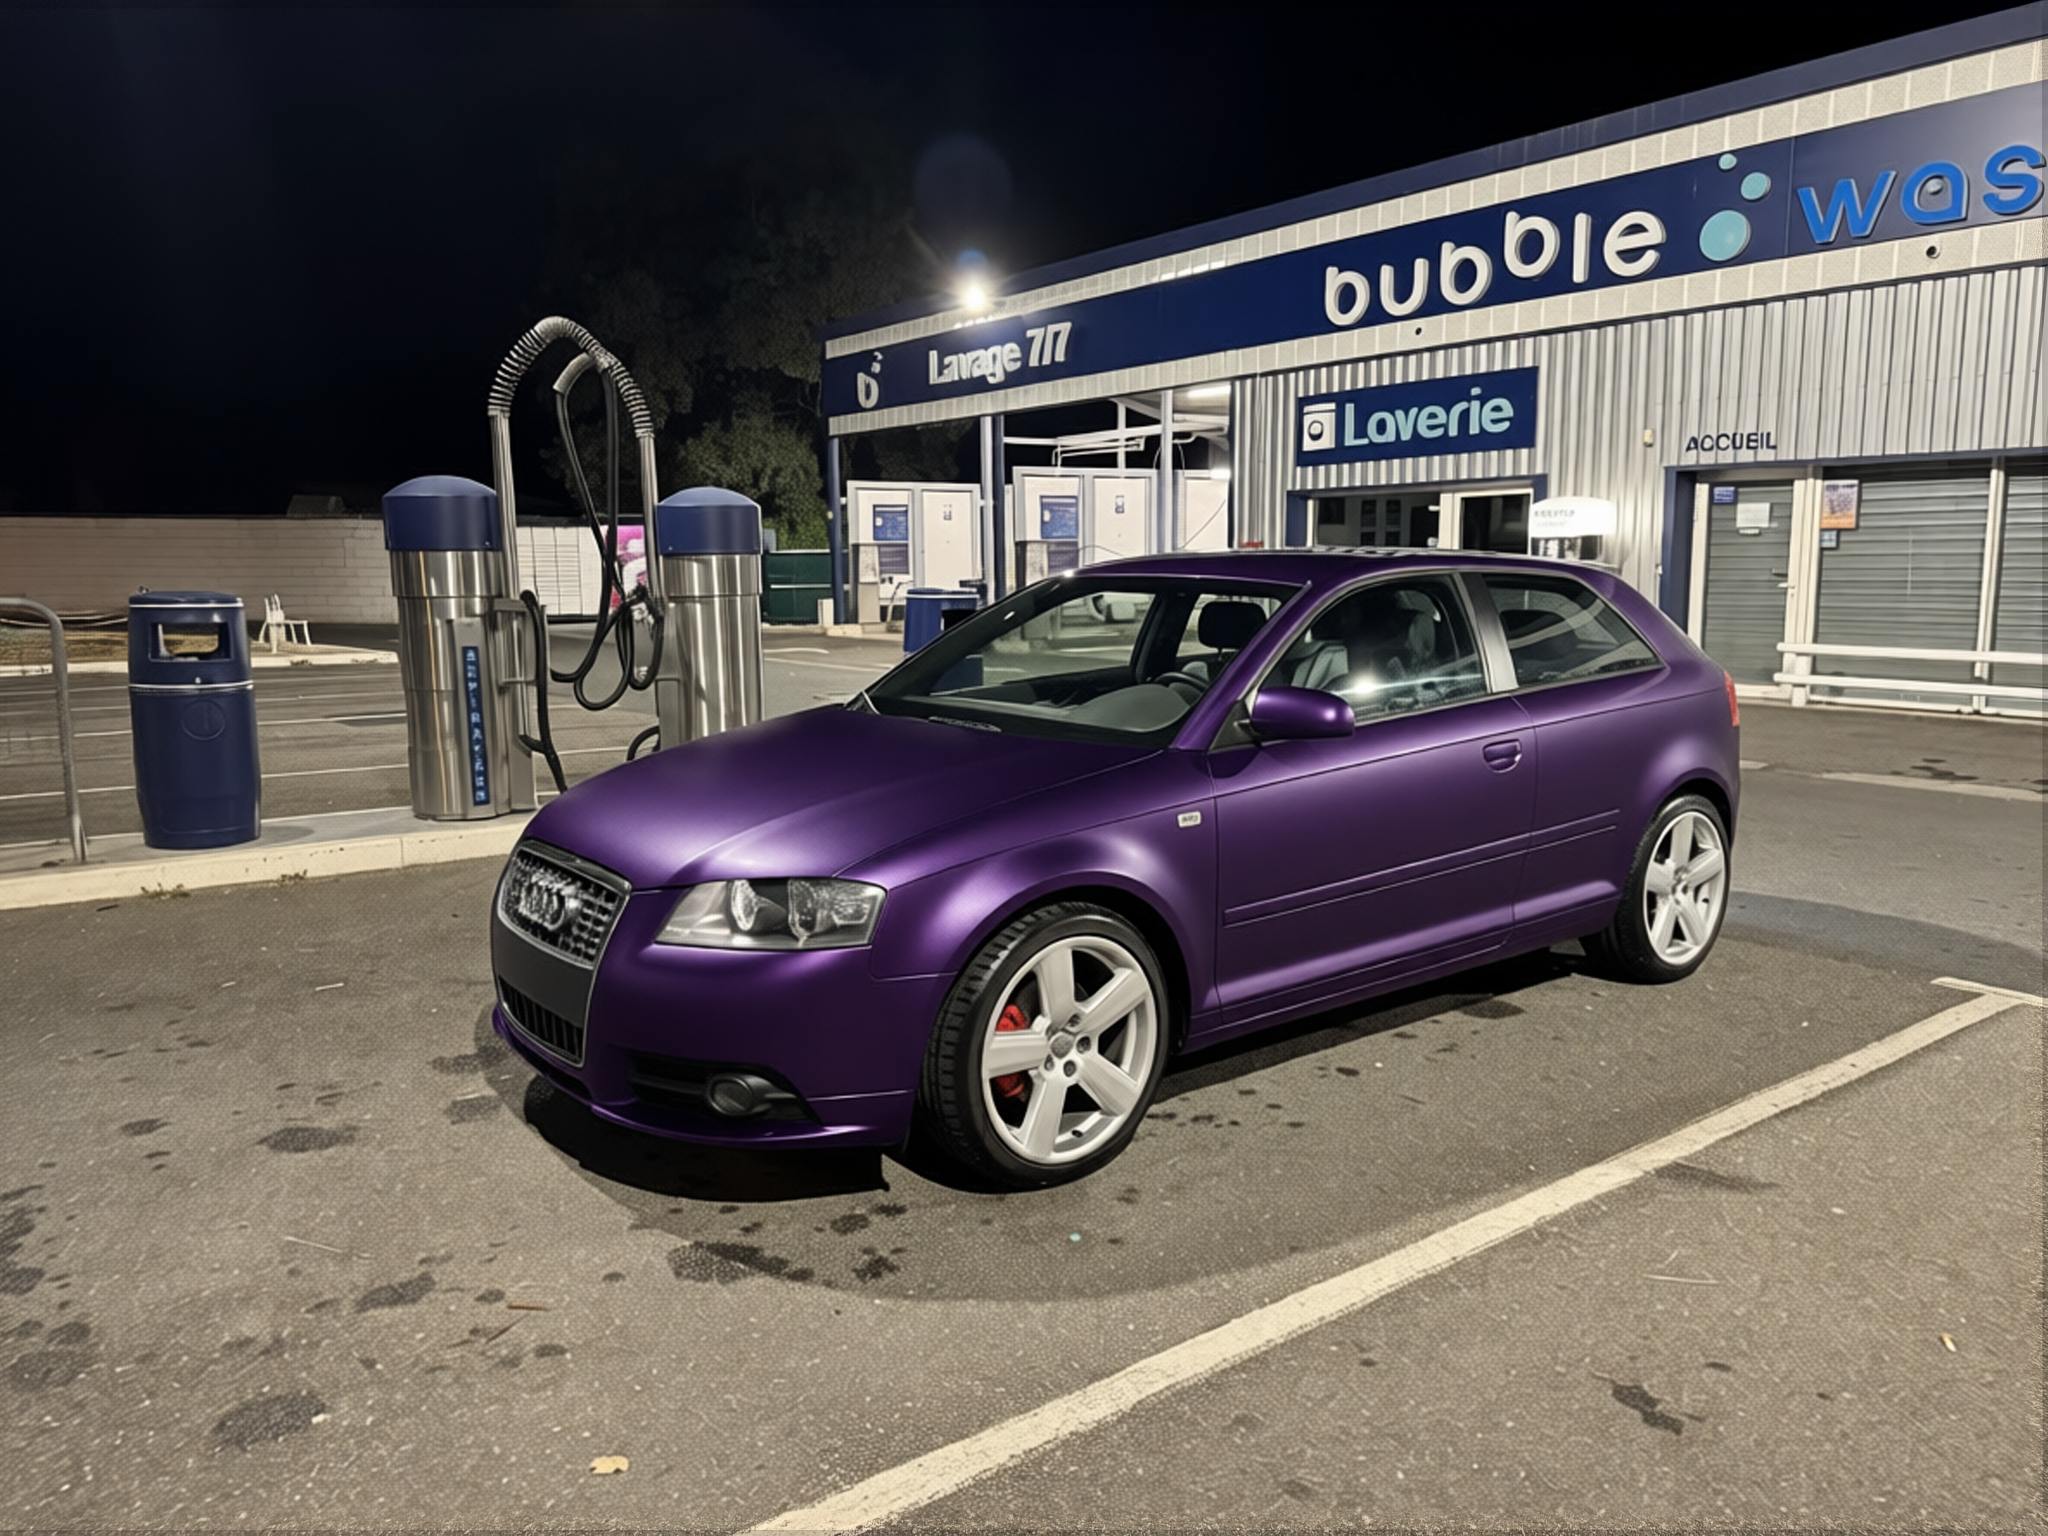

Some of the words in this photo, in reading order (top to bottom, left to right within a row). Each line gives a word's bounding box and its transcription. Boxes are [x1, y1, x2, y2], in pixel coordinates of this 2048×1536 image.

[1324, 210, 1666, 327] bubble
[1796, 144, 2047, 245] was
[1344, 387, 1514, 446] Laverie
[1686, 431, 1777, 452] ACCUEIL
